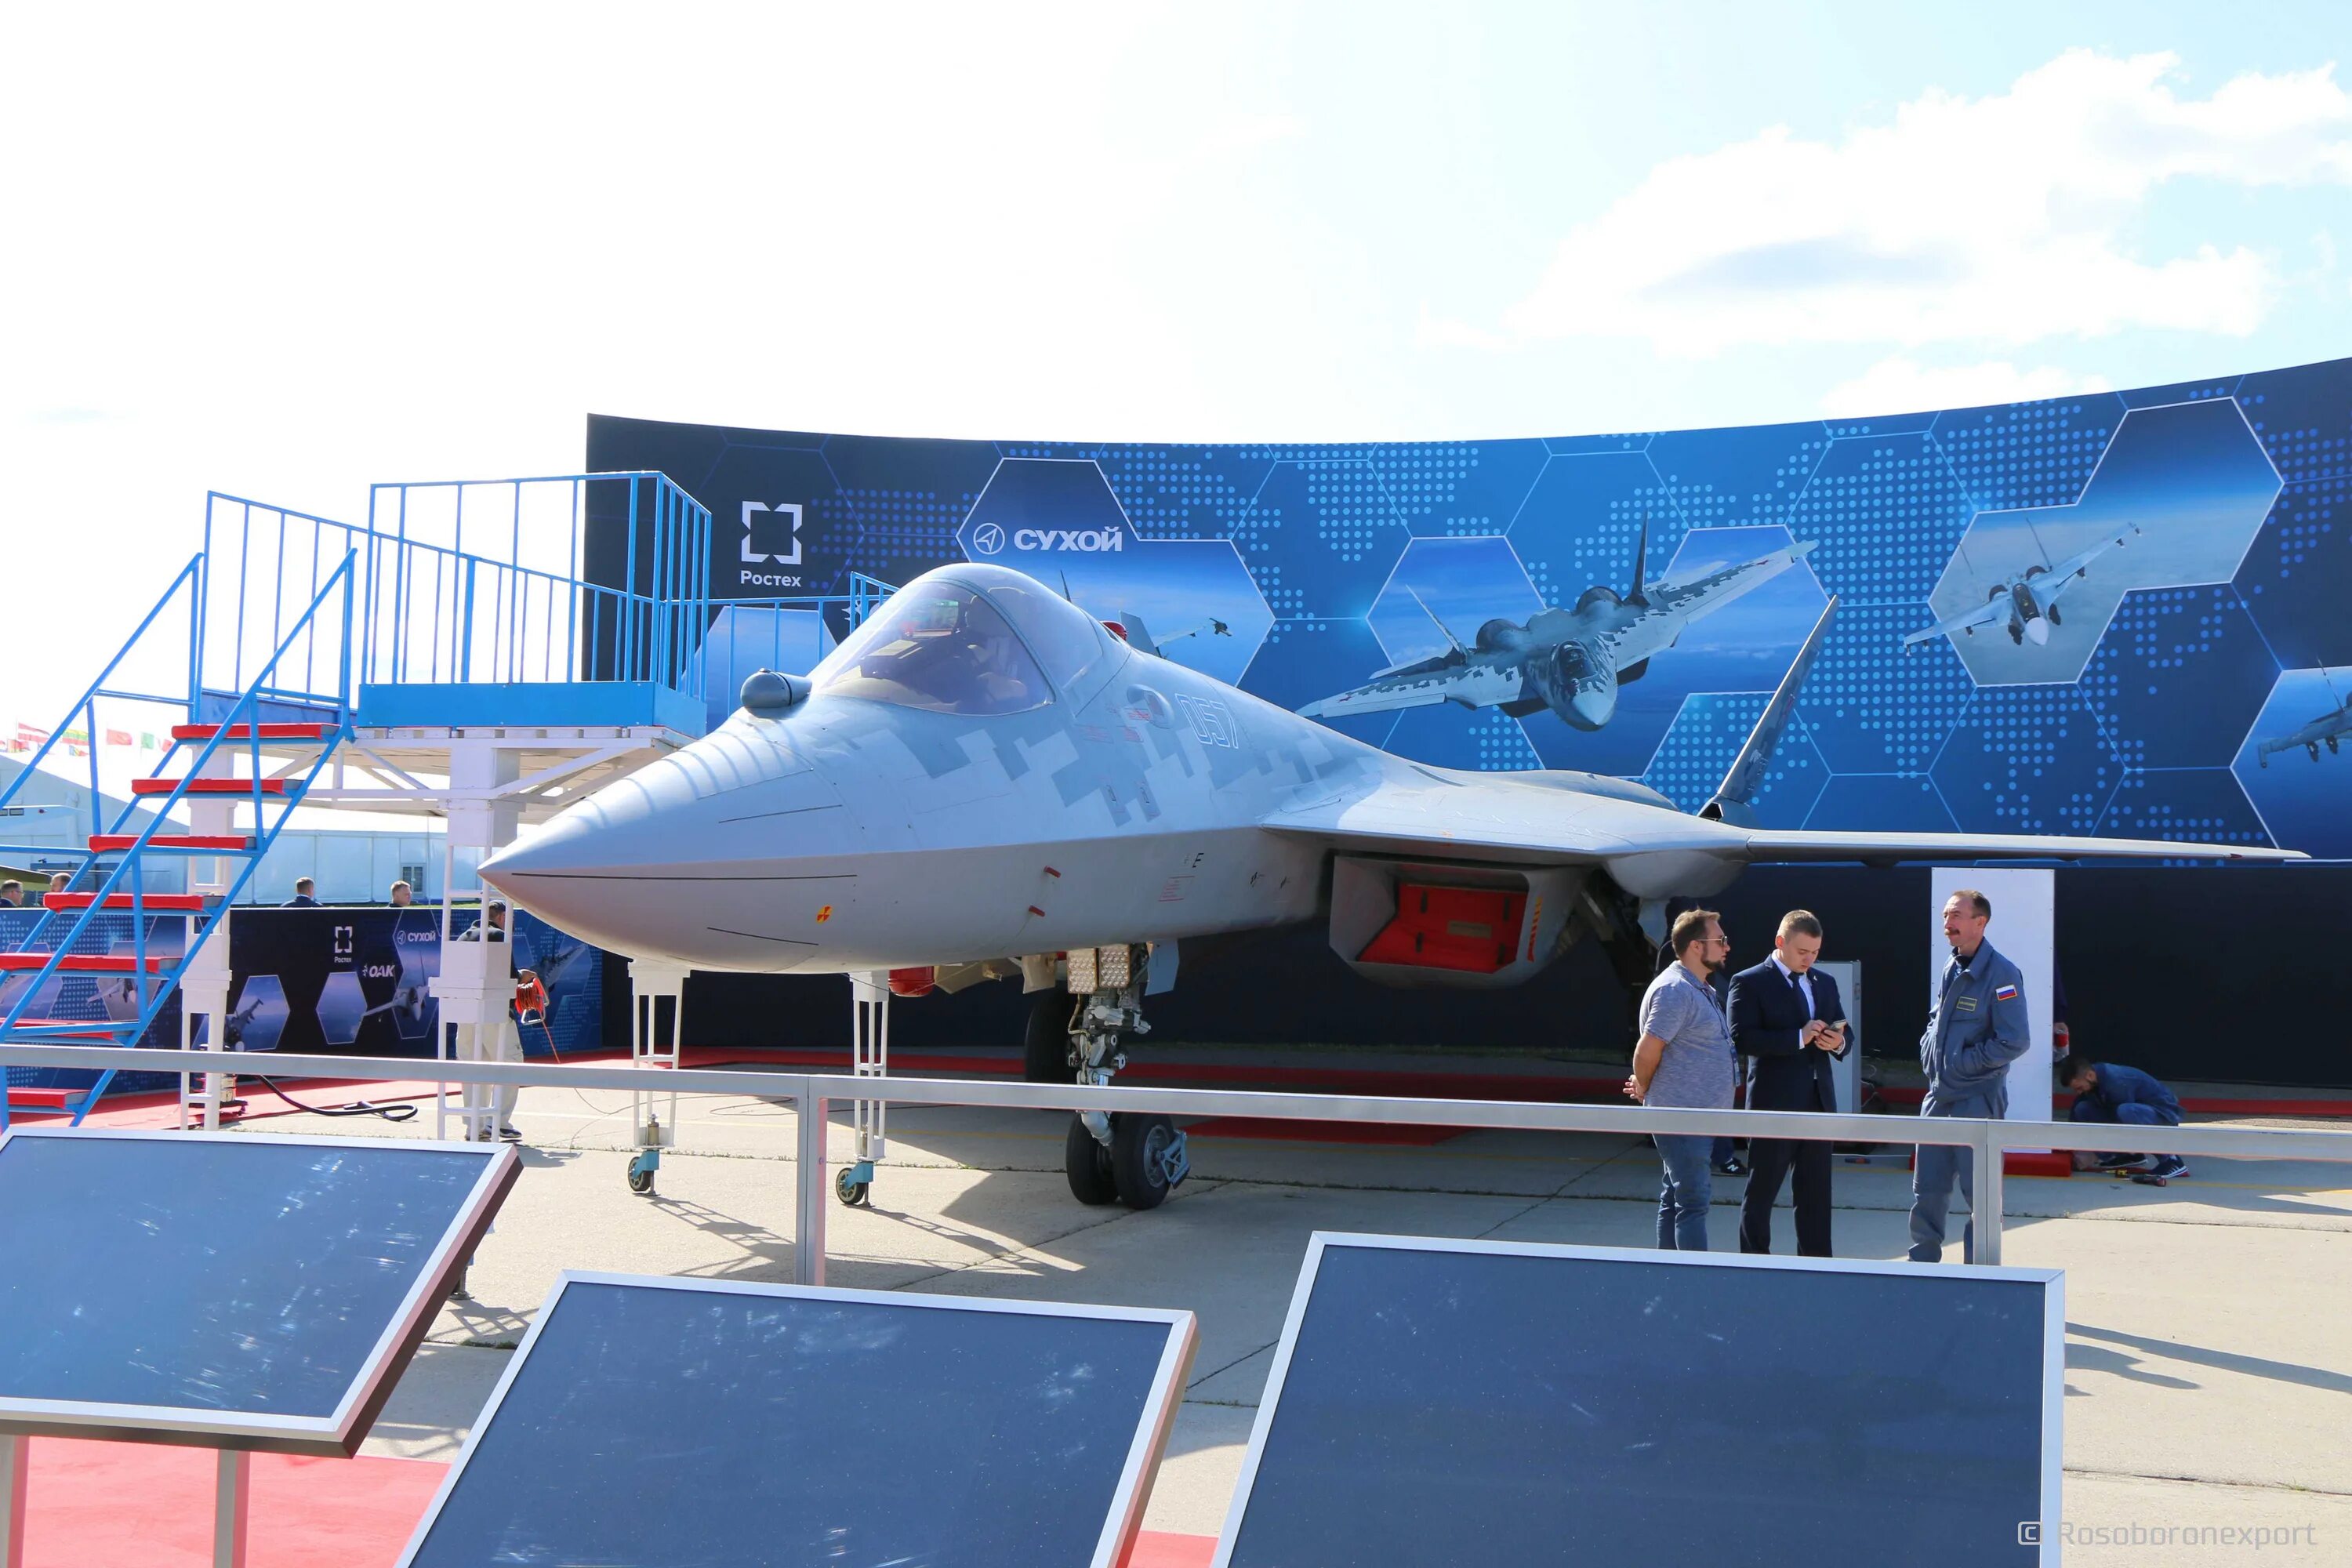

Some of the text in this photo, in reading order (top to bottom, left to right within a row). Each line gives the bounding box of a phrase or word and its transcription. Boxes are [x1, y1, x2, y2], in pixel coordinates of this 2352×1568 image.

[1014, 526, 1122, 552] СУХОЙ
[740, 570, 801, 587] Ростех
[408, 931, 436, 942] СУХОЙ
[368, 964, 395, 978] ОАК
